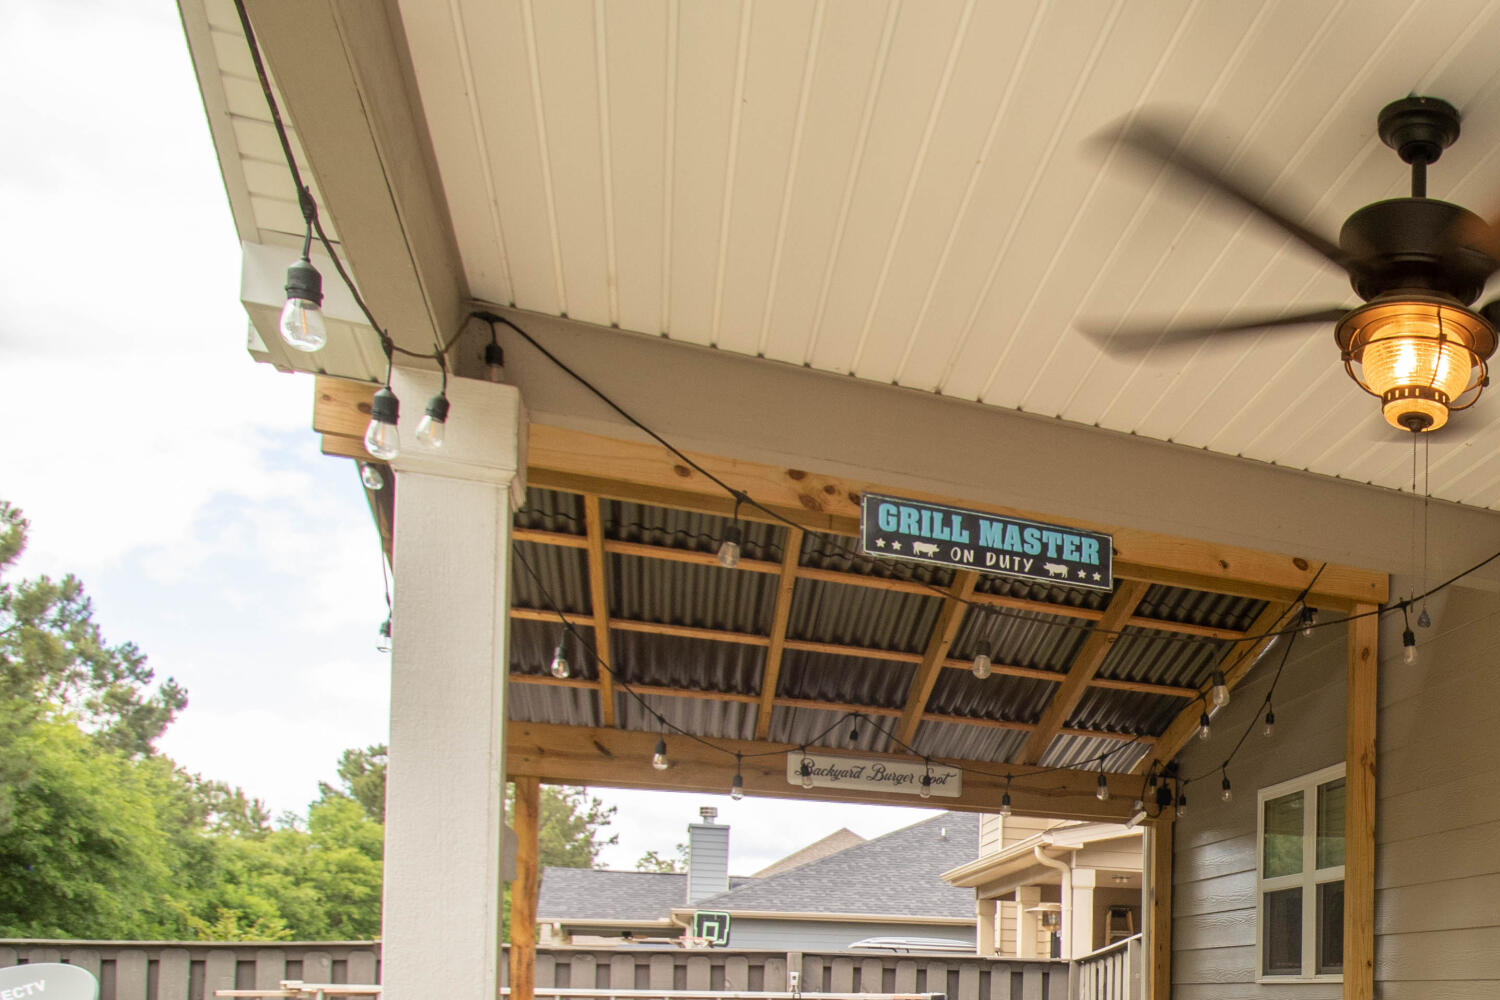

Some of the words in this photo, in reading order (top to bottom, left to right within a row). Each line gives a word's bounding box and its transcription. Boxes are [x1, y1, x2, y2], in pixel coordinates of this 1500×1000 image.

[878, 503, 970, 544] GRILL
[979, 519, 1100, 565] MASTER
[950, 546, 974, 563] ON
[986, 553, 1034, 573] DUTY
[794, 757, 866, 781] Backyard
[866, 763, 914, 785] Burger
